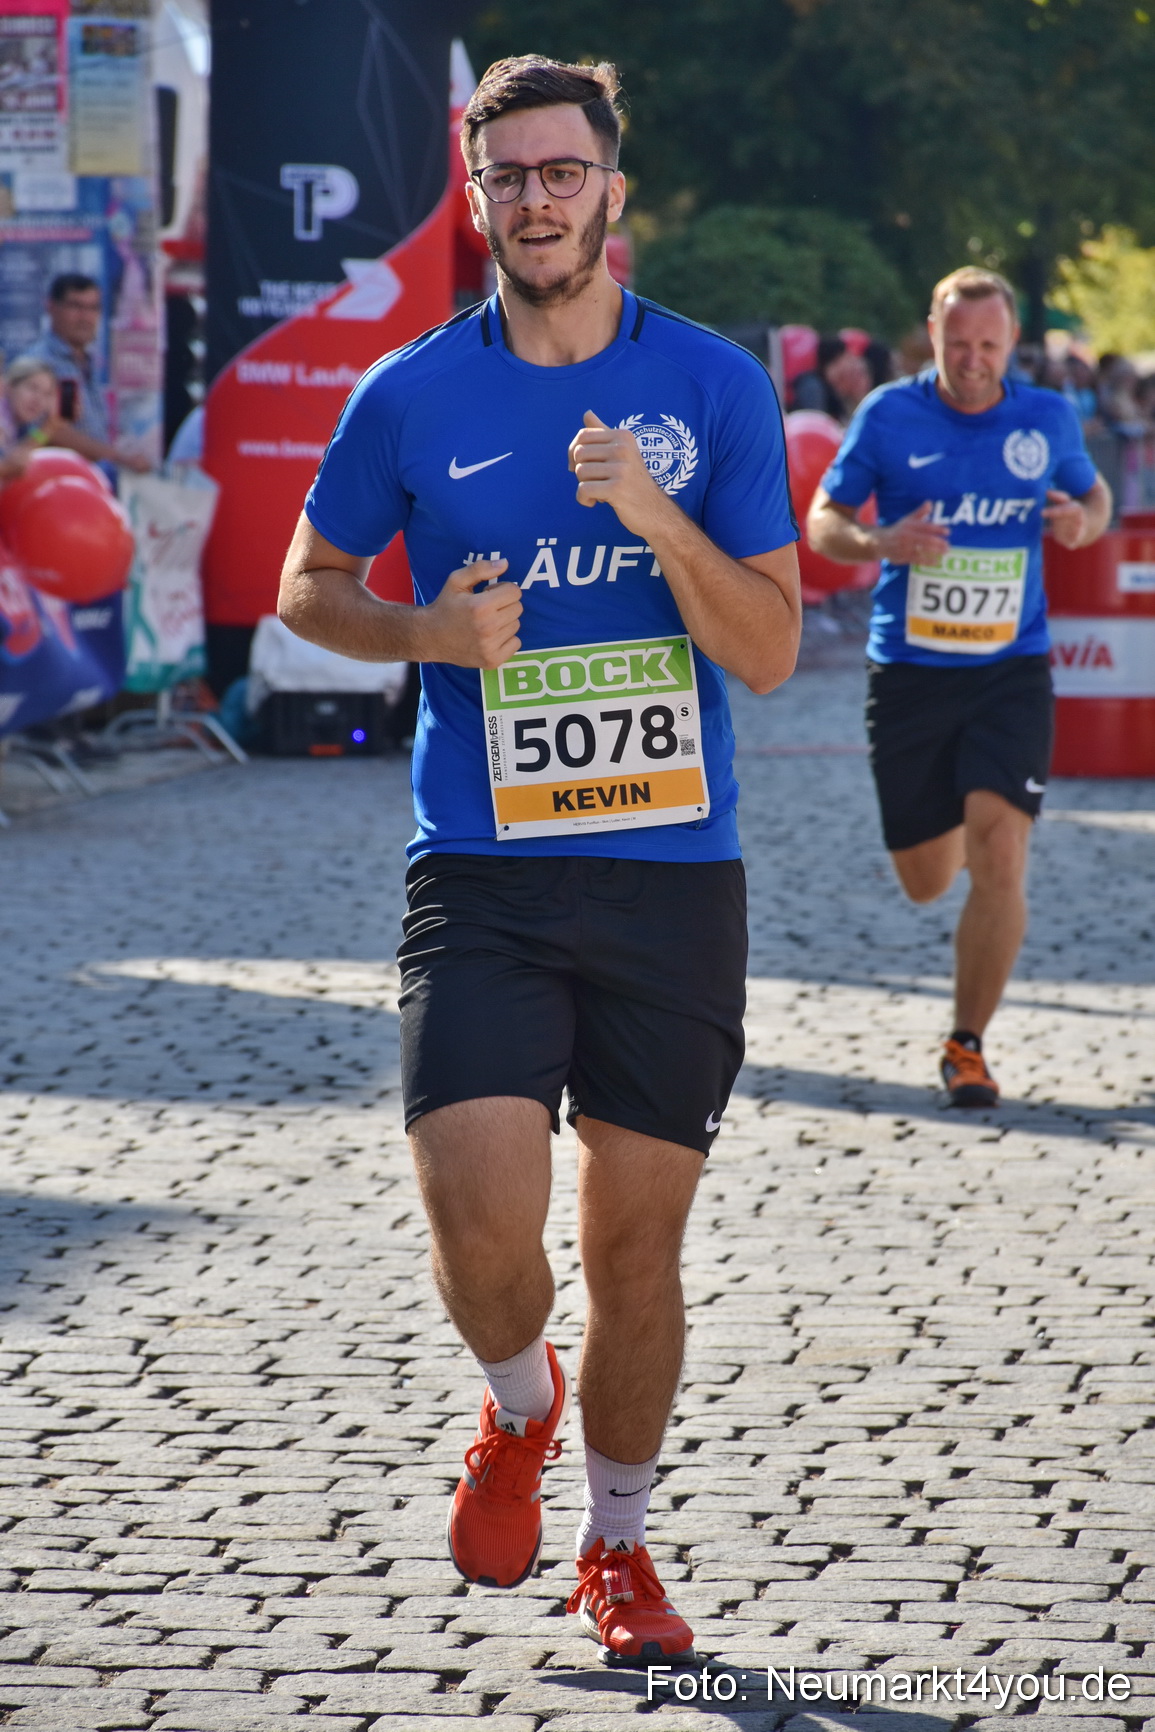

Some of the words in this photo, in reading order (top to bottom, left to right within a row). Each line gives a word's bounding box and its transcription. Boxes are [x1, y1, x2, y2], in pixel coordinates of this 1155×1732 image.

[634, 427, 680, 448] schutztechnik
[640, 449, 686, 459] ÖPSTER
[921, 491, 1036, 526] LÄUFT
[921, 583, 1010, 616] 5077
[931, 624, 995, 639] MARCO
[499, 647, 678, 701] BOCK
[681, 707, 689, 716] S
[514, 704, 678, 772] 5078
[552, 782, 651, 812] KEVIN
